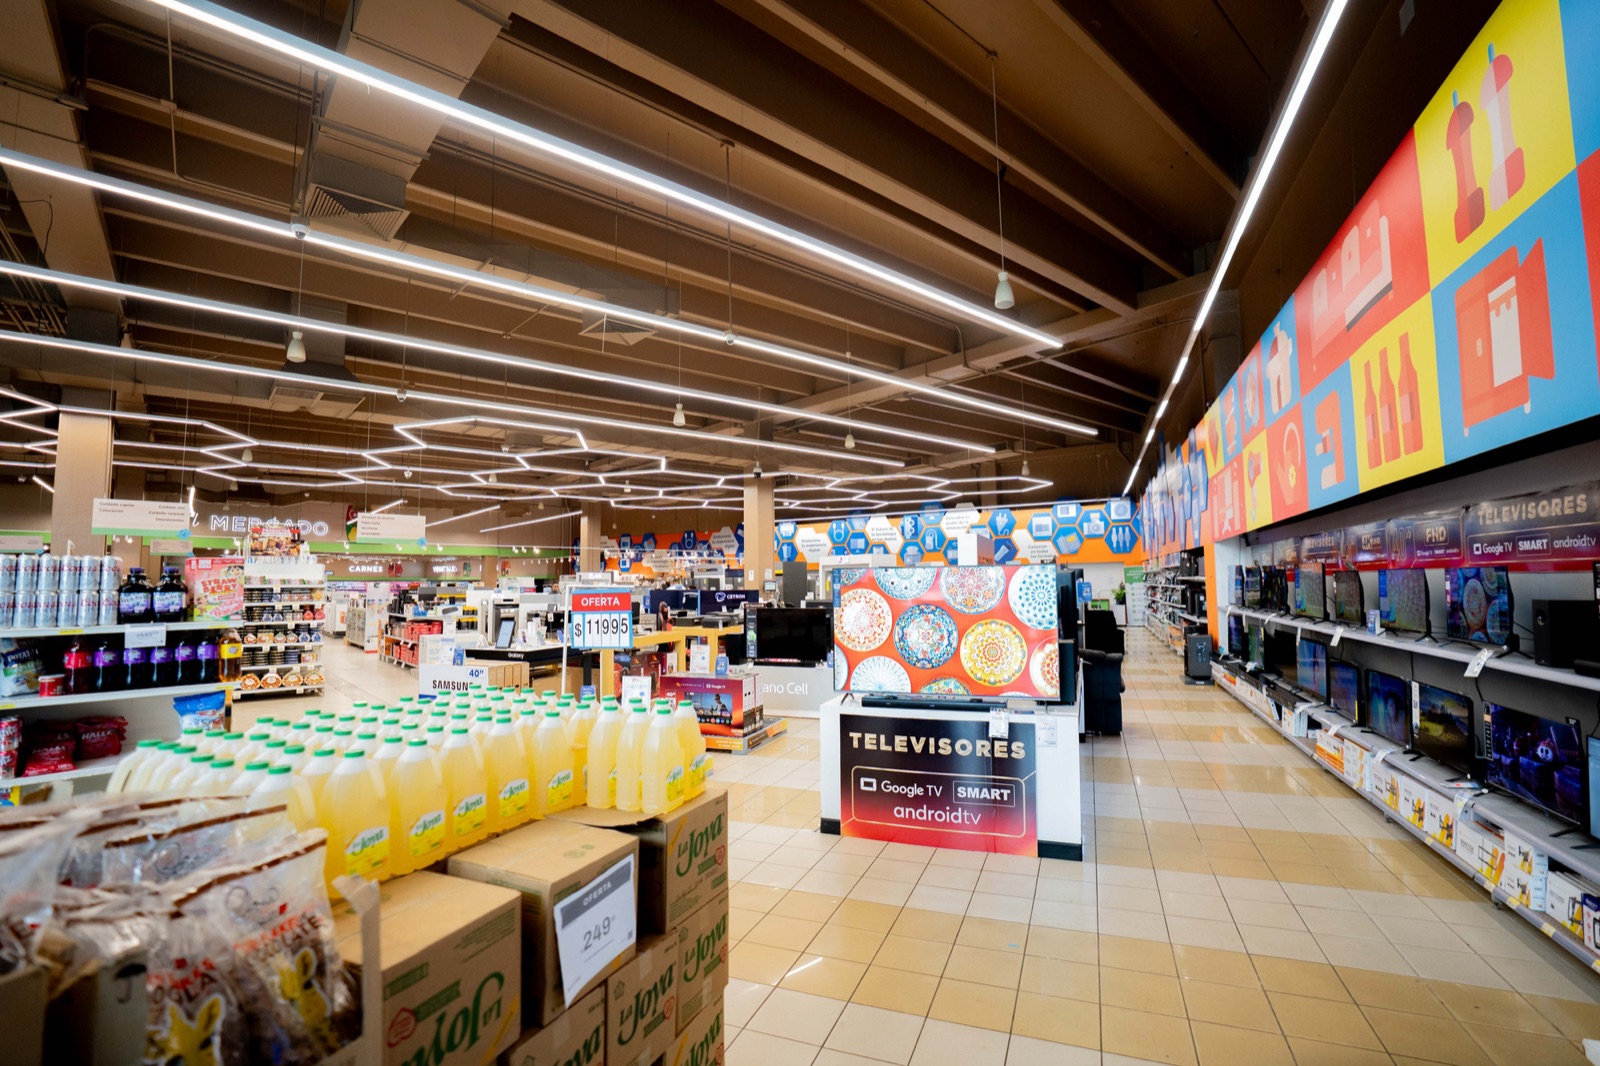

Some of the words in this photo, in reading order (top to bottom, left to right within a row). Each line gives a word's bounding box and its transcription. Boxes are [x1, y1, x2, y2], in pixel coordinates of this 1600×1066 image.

[1477, 494, 1588, 526] TELEVISORES
[1425, 526, 1447, 543] FHD
[1482, 543, 1504, 556] Google
[1504, 542, 1513, 552] TV
[1518, 538, 1548, 551] SMART
[1553, 534, 1596, 549] androidtv
[201, 577, 237, 586] STRAW
[203, 583, 237, 594] BERRY
[581, 597, 620, 606] OFERTA
[469, 669, 484, 678] 40"
[432, 680, 473, 691] SAMSUN
[762, 682, 784, 694] ano
[786, 682, 809, 695] Cell
[849, 732, 1026, 760] TELEVISORES
[503, 781, 526, 801] Joya
[881, 780, 924, 798] Google
[925, 784, 943, 797] TV
[956, 786, 1010, 801] SMART
[458, 796, 483, 817] Joya
[893, 804, 982, 825] androidtv
[414, 813, 442, 837] Joya
[351, 829, 384, 856] Joya
[676, 814, 723, 877] Joya
[678, 841, 688, 858] La
[583, 881, 612, 906] OFERTA
[583, 916, 611, 951] 249
[683, 914, 727, 983] Joya
[685, 950, 696, 965] La
[617, 963, 674, 1046] Joya
[619, 1004, 632, 1026] La
